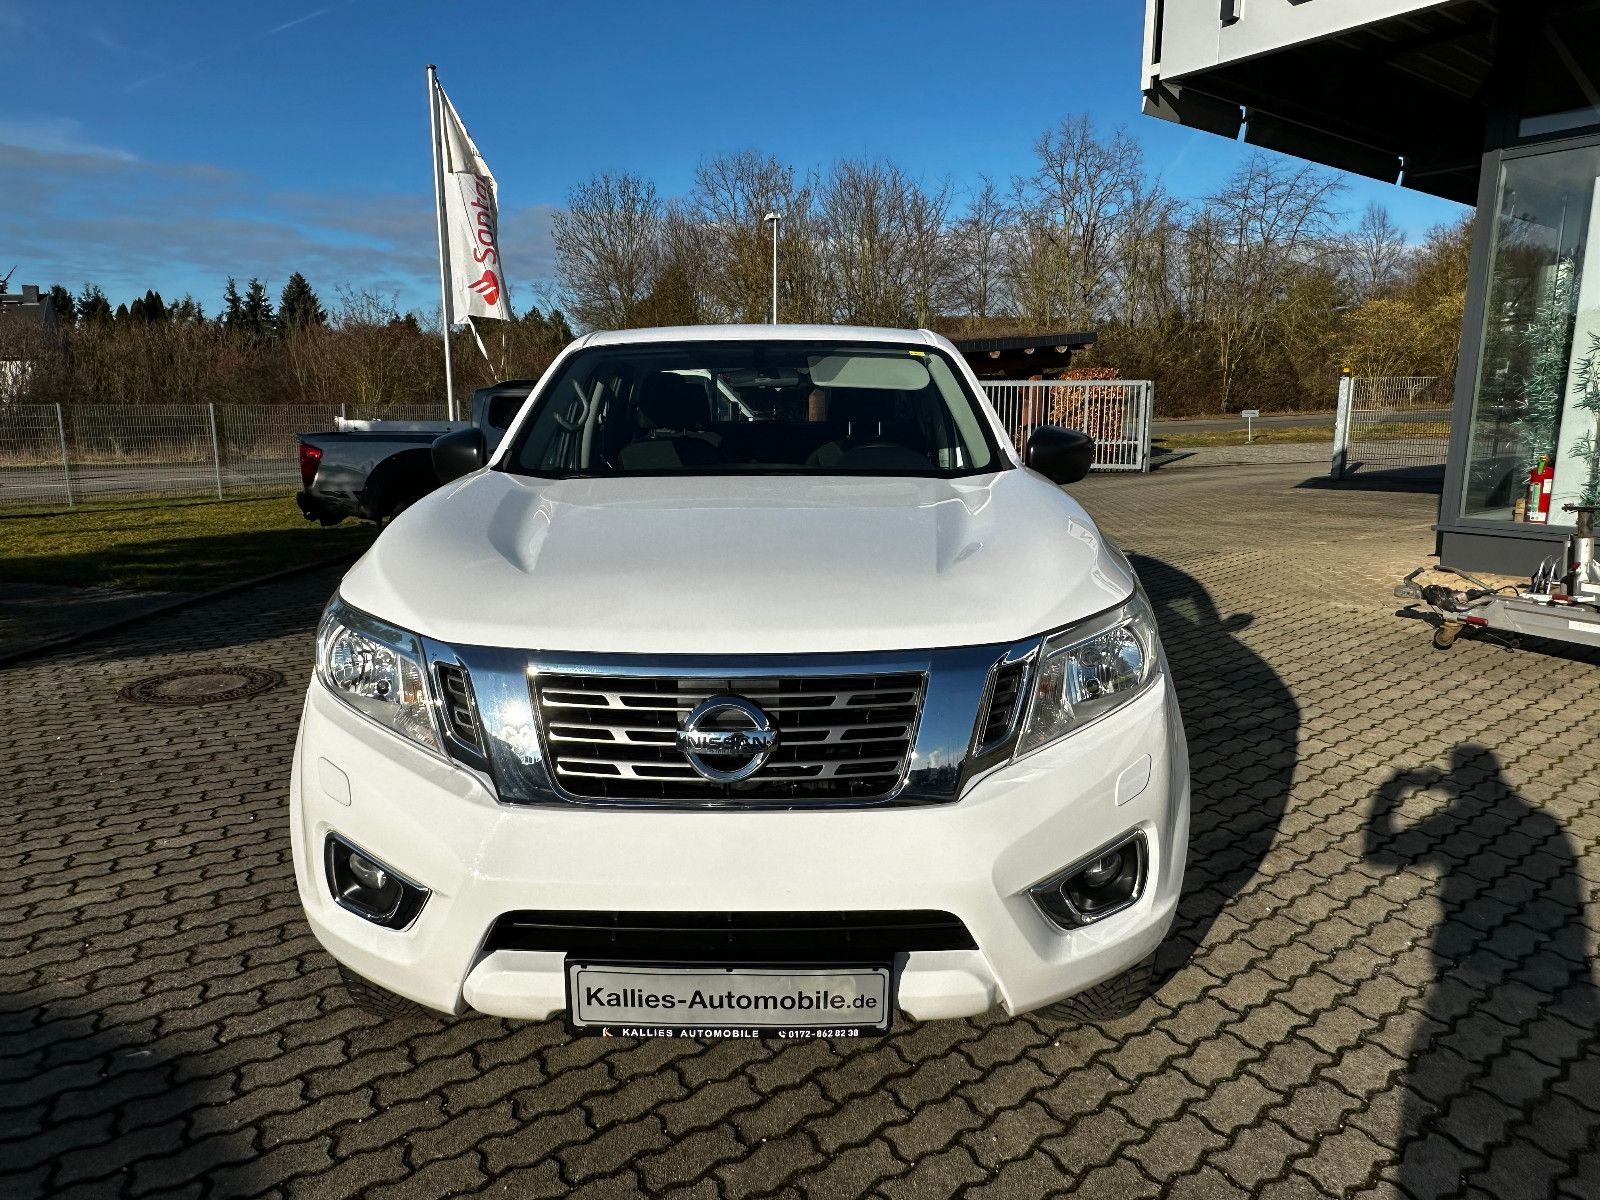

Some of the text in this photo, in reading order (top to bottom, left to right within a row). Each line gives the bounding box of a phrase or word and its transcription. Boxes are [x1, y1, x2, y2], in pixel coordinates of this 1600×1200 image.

[686, 735, 768, 750] NISSAN
[587, 987, 878, 1010] Kallies-Automobile.de
[622, 1028, 673, 1038] KALLIES
[680, 1029, 759, 1038] AUTOMOBILE
